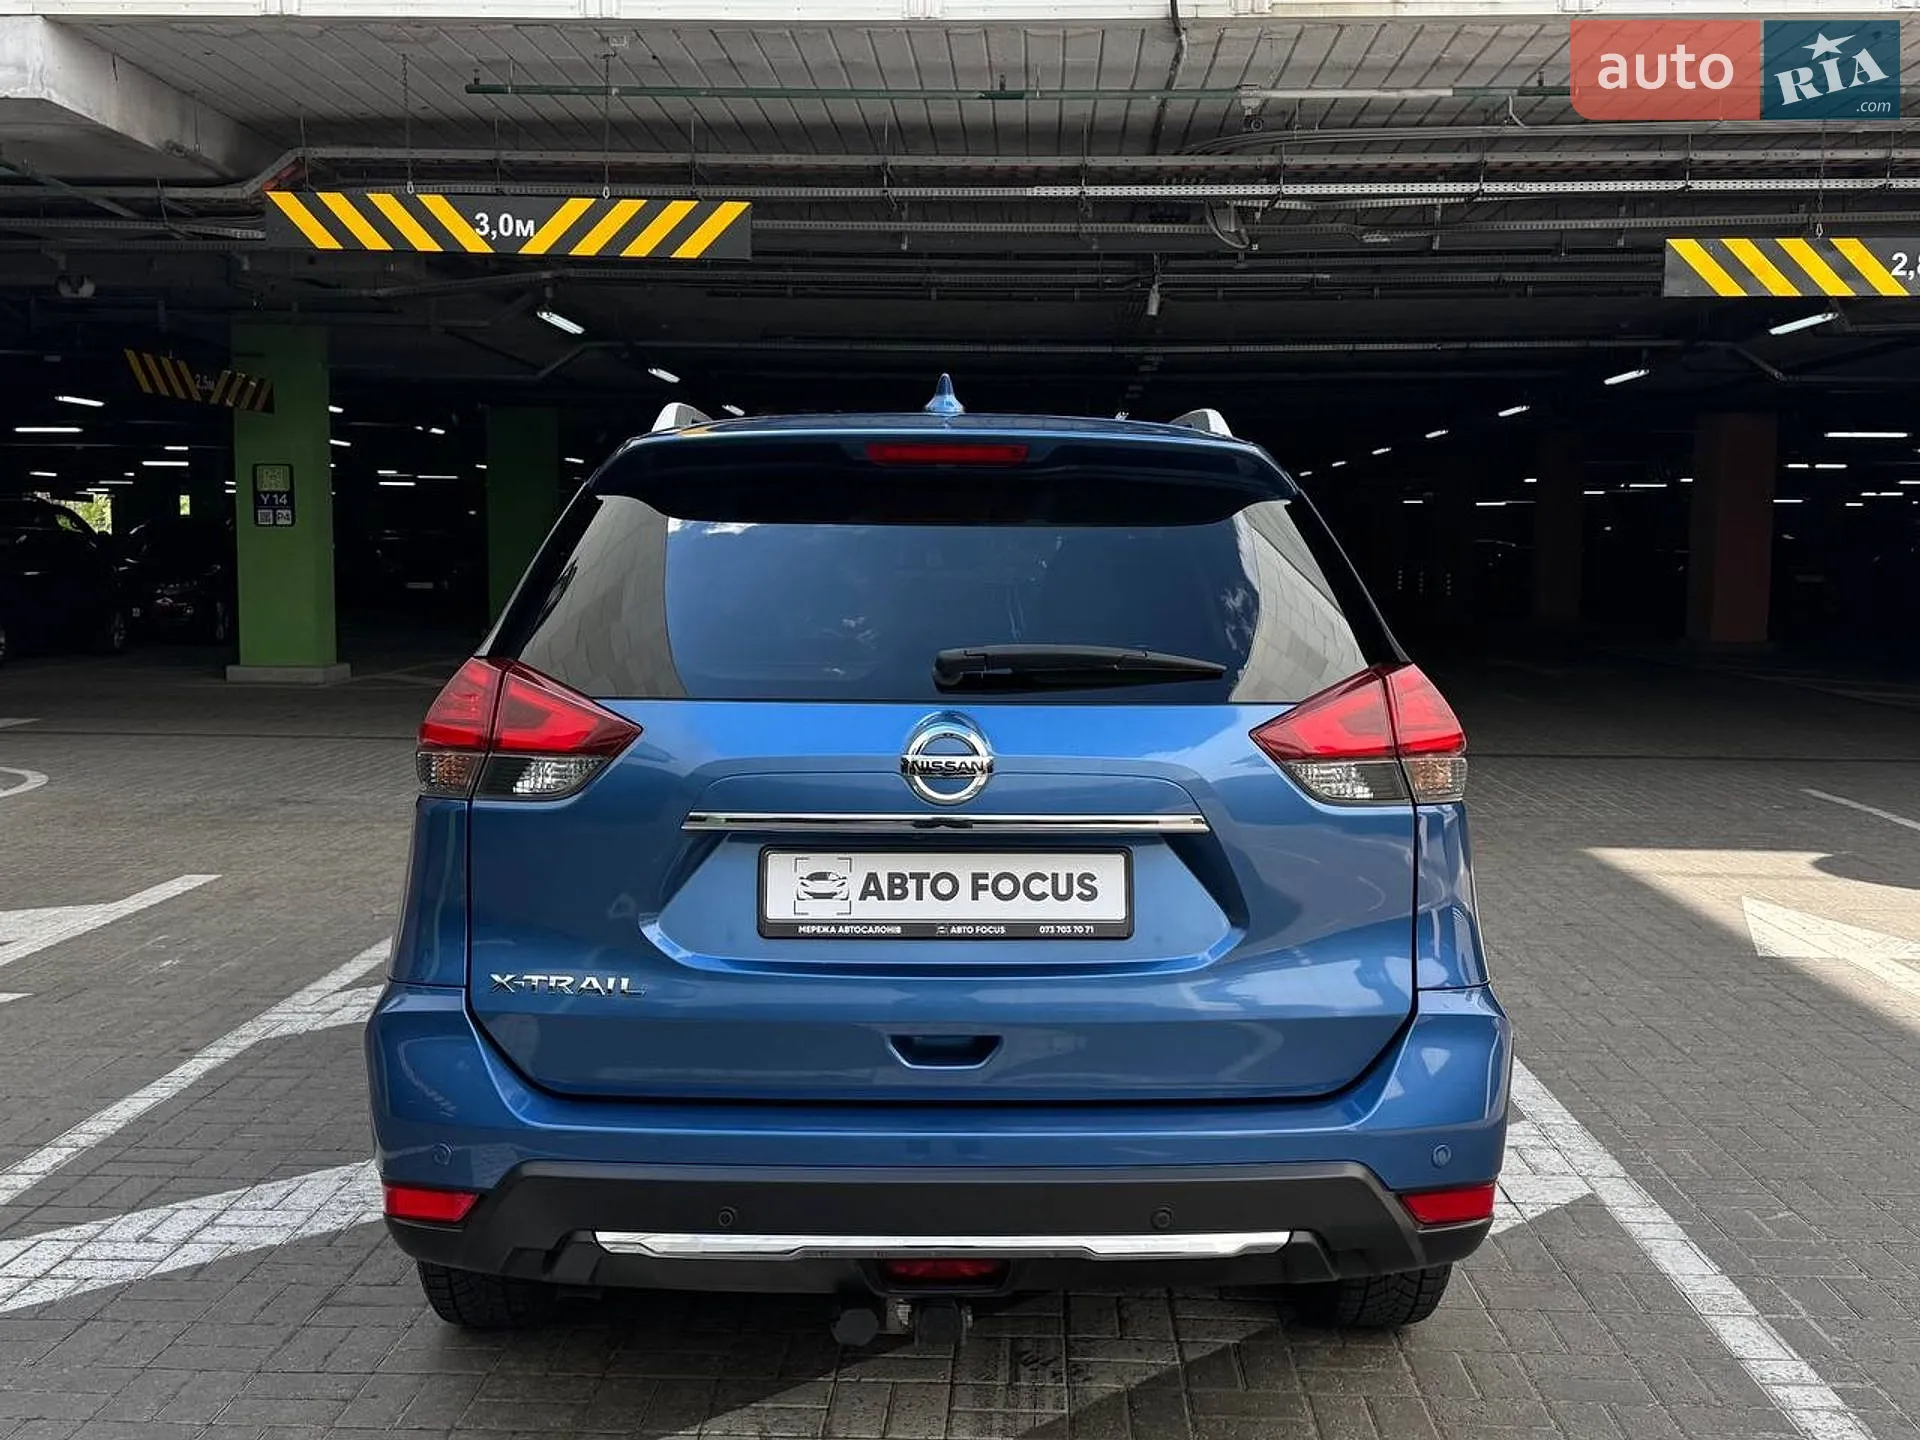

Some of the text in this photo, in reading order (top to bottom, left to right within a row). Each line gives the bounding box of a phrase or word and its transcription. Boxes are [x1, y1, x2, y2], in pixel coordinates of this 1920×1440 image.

[1891, 251, 1920, 281] 2,
[260, 494, 288, 505] Y 14
[908, 760, 984, 774] NISSAN
[859, 871, 1099, 902] АВТО FOCUS
[950, 925, 1007, 935] АВТО FOCUS
[489, 973, 647, 997] X-TRAIL
